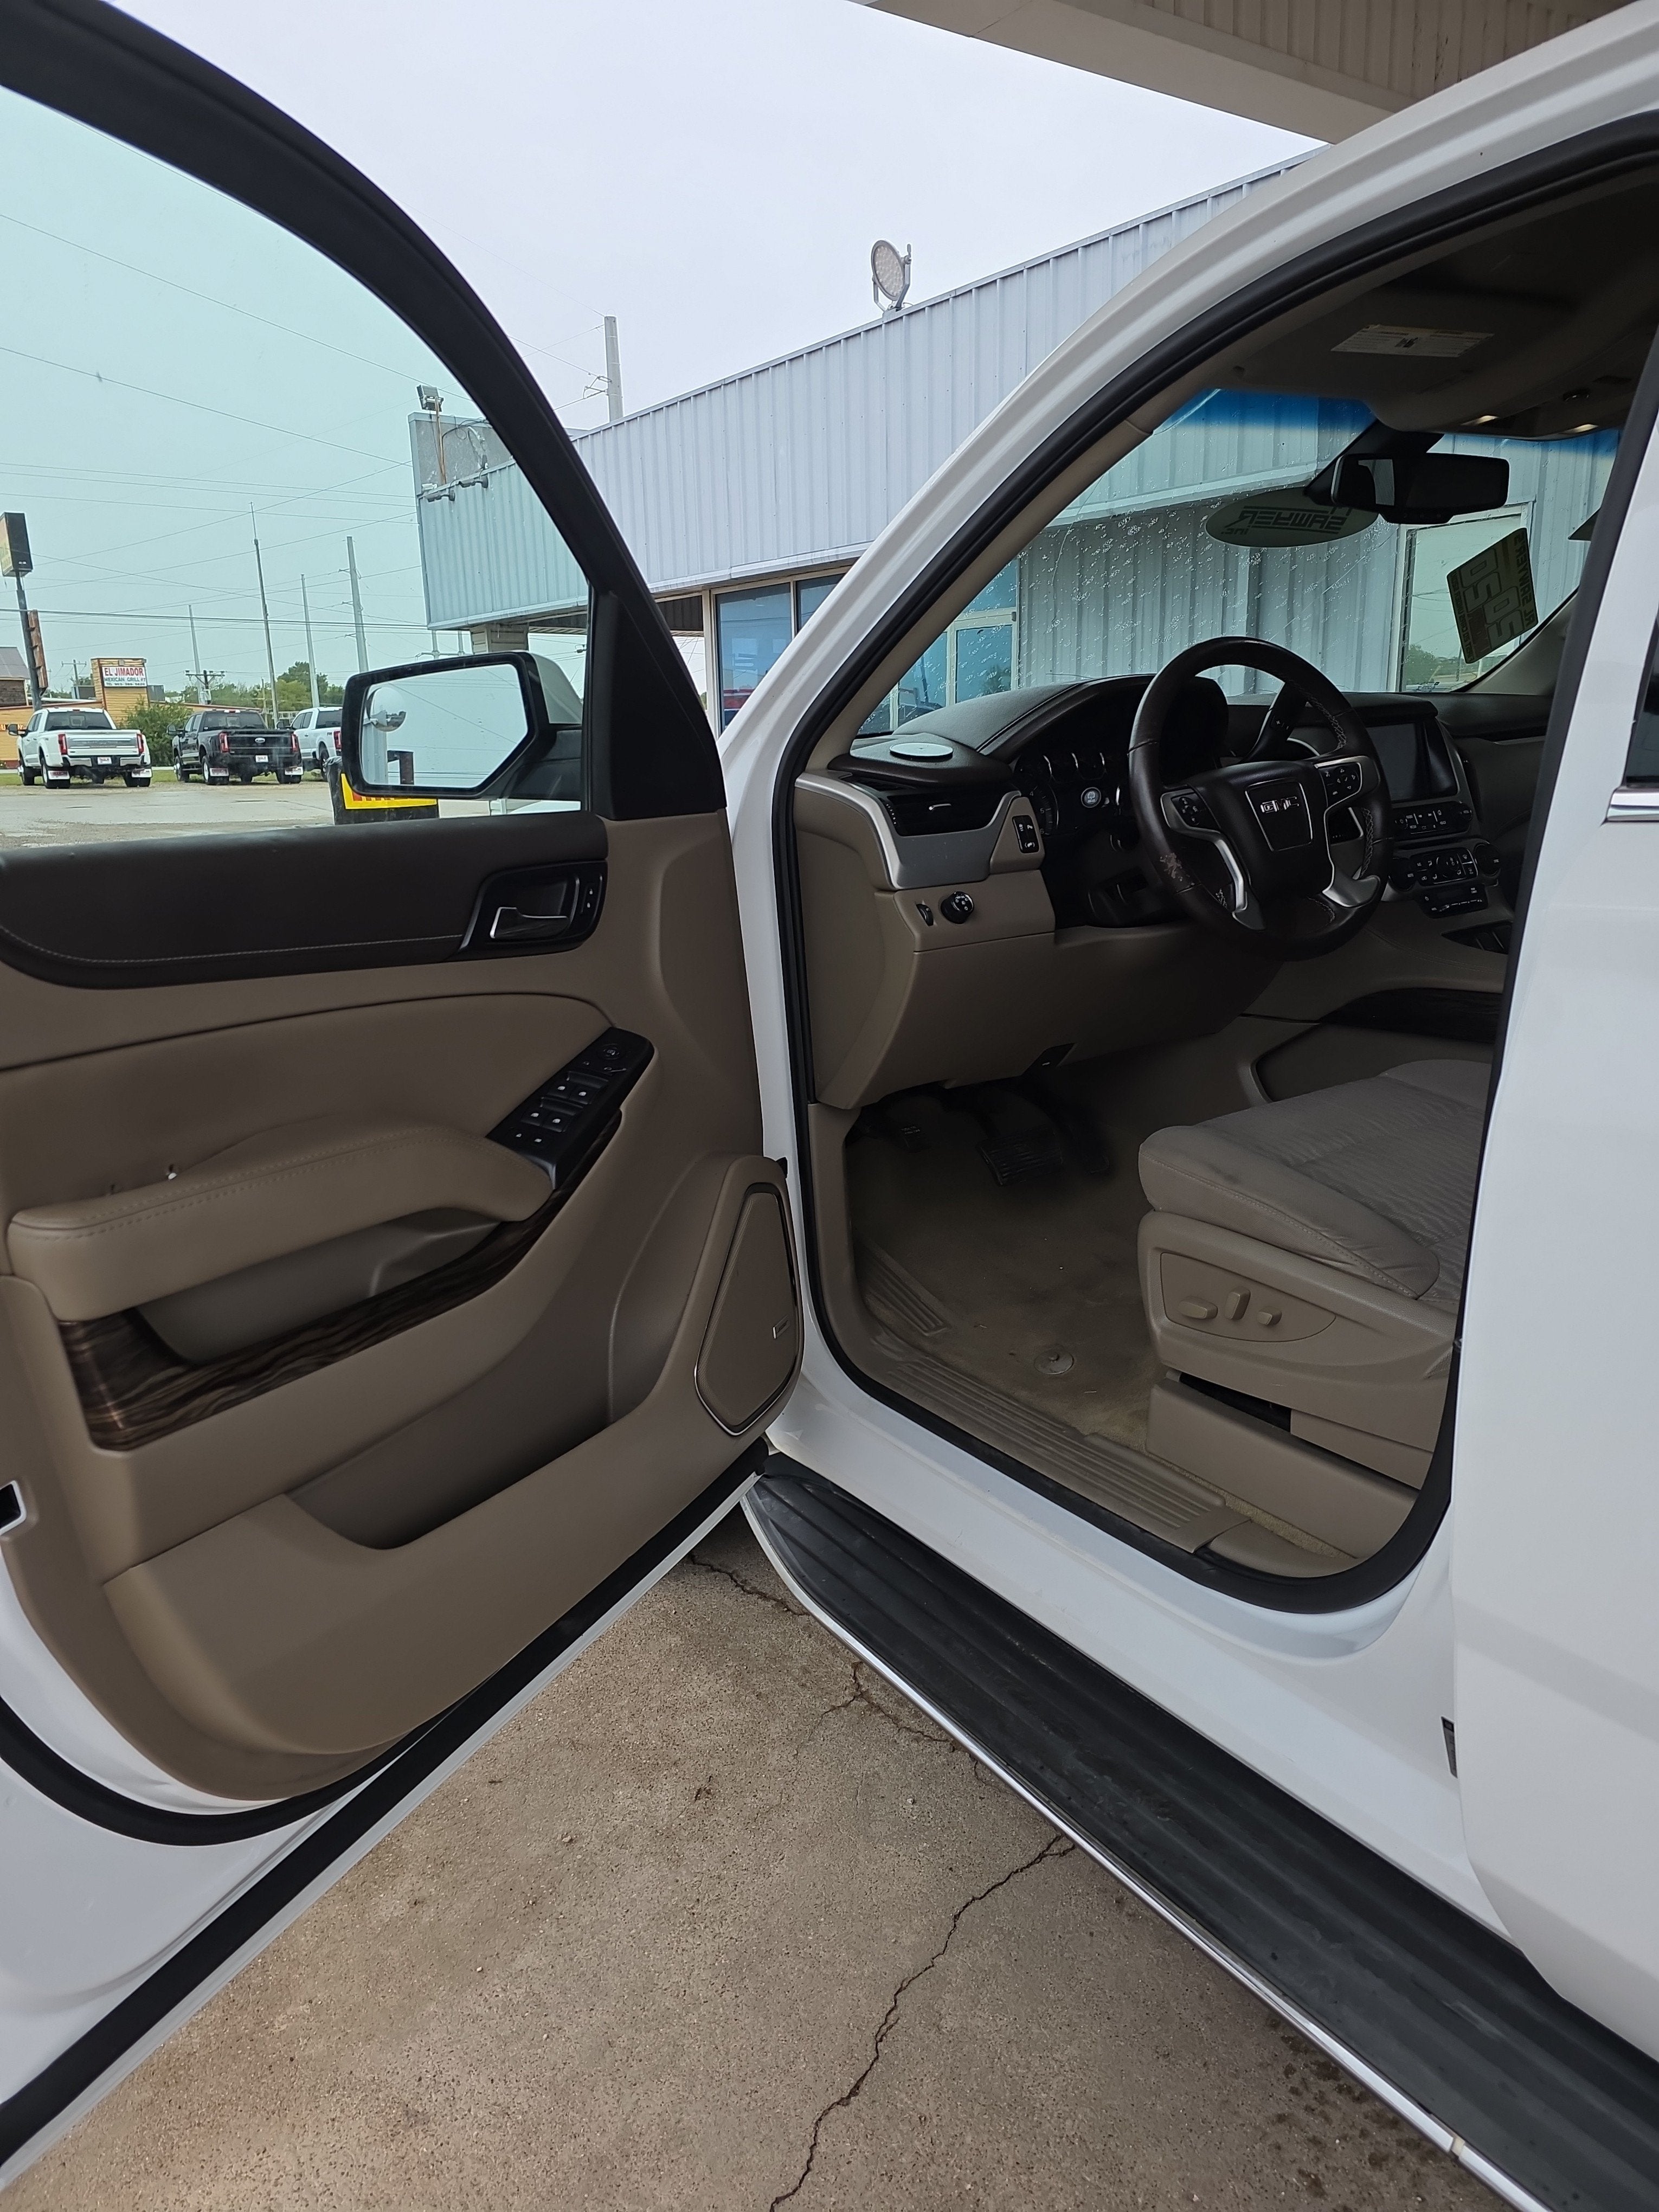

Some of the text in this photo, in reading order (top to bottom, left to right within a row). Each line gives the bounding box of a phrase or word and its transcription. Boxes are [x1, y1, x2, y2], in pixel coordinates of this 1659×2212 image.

[105, 667, 144, 676] EL JIMADOR
[1259, 796, 1300, 814] GMC
